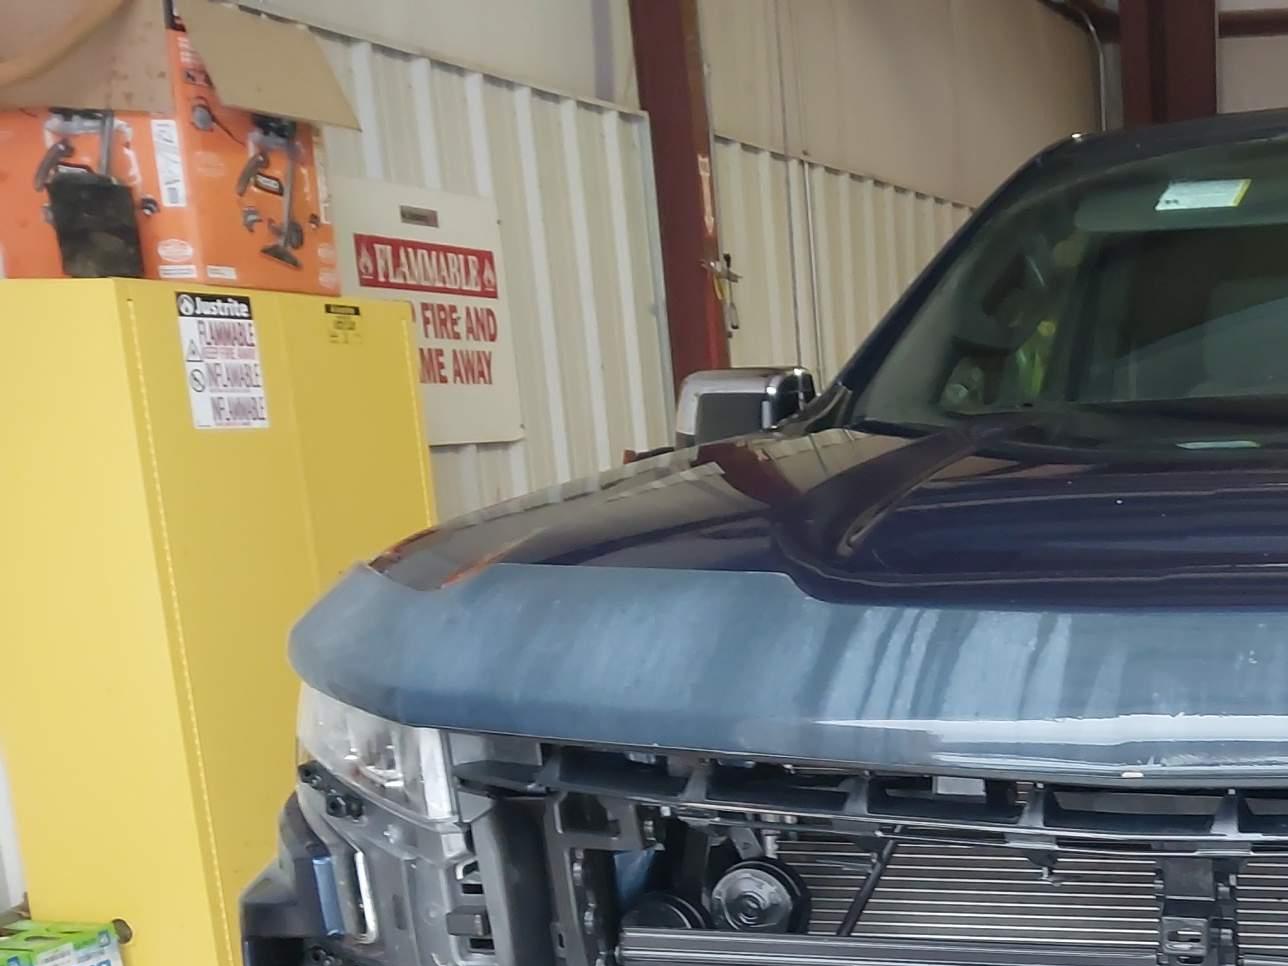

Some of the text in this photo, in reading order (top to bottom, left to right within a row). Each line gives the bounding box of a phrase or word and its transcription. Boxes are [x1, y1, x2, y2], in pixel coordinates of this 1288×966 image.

[373, 243, 482, 292] FLAMMABLE
[195, 296, 250, 318] Justrite
[419, 302, 462, 340] FIRE
[465, 306, 498, 342] AND
[197, 319, 256, 347] FLAMMABLE
[452, 349, 493, 385] AWAY
